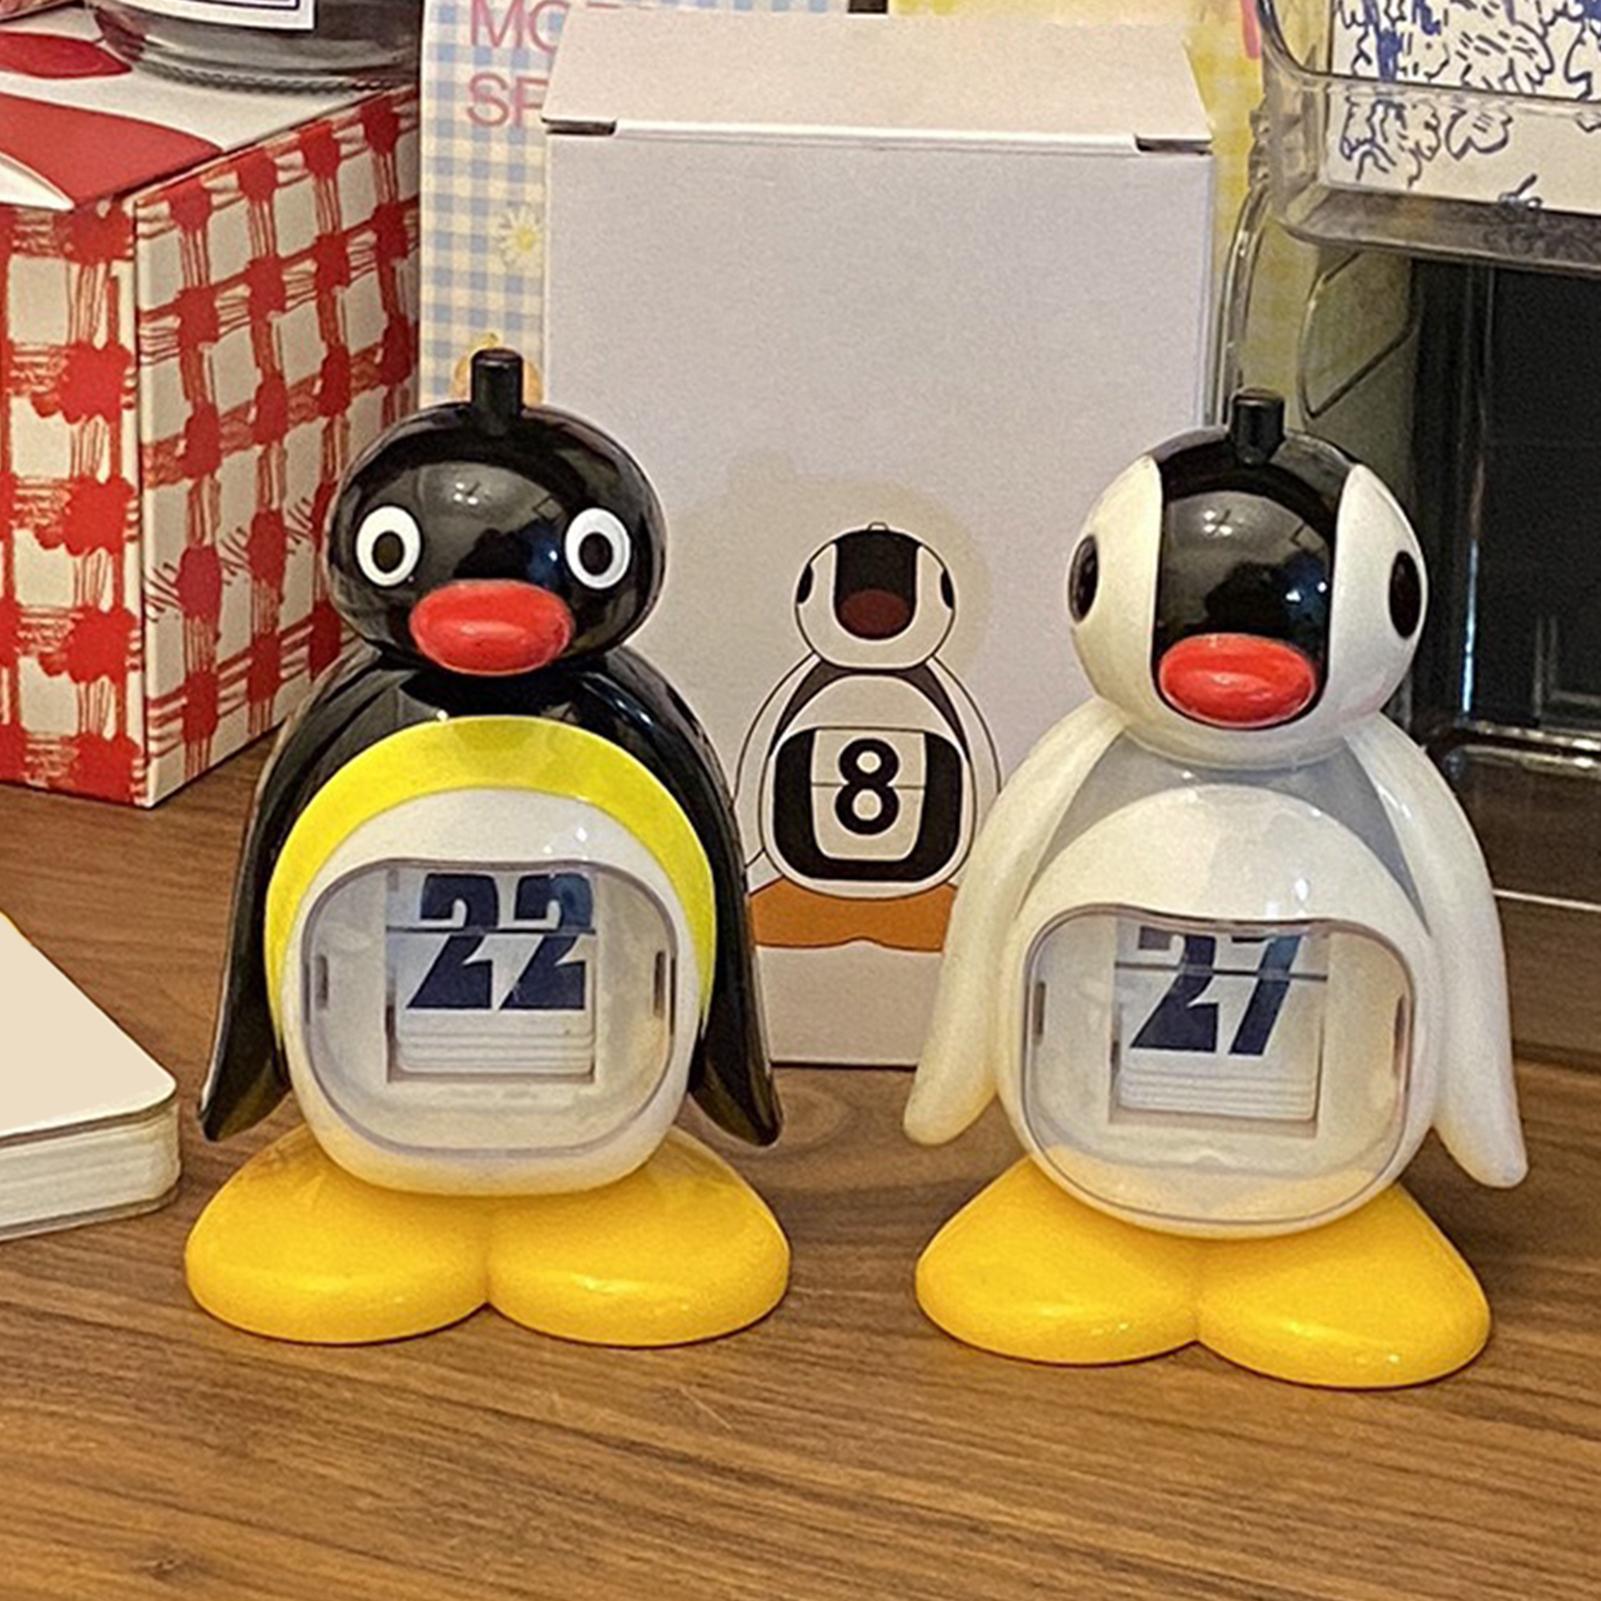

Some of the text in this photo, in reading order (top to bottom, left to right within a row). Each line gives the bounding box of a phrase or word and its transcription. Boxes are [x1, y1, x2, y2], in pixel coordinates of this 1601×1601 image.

[835, 738, 900, 836] 8
[406, 873, 593, 1010] 22
[1130, 925, 1302, 1055] 27
